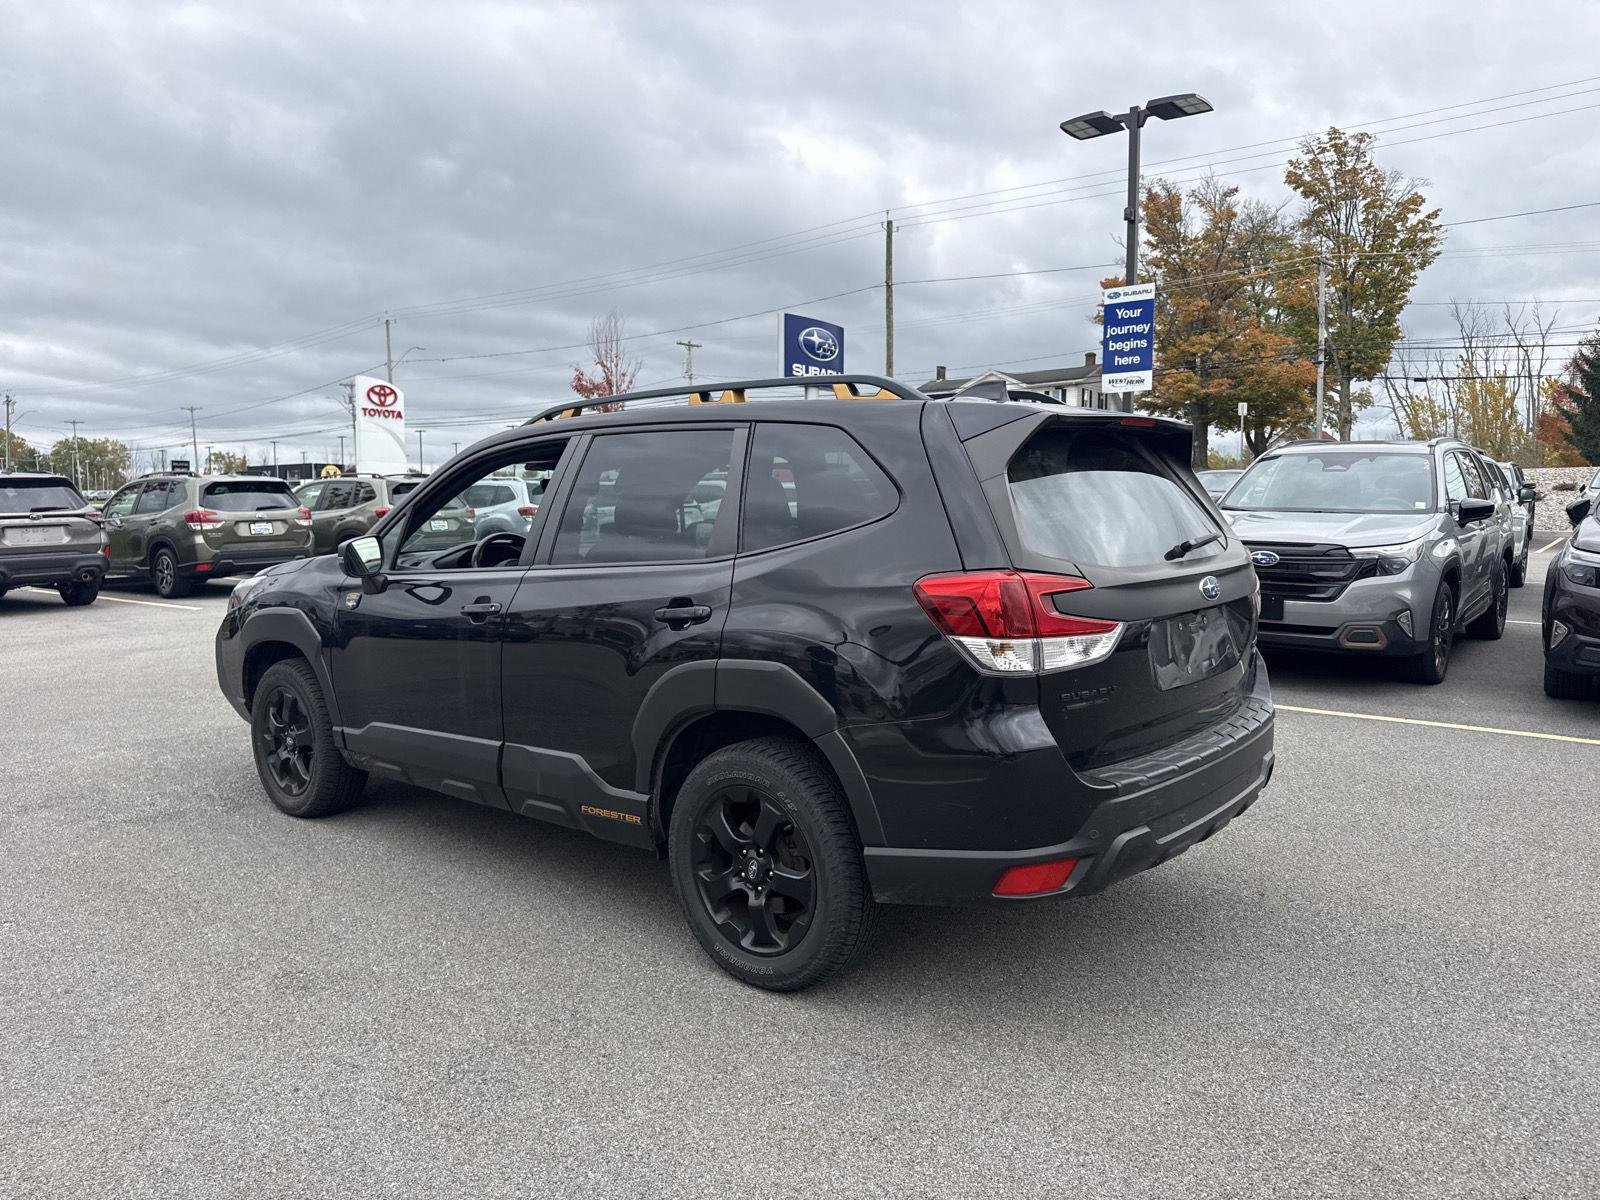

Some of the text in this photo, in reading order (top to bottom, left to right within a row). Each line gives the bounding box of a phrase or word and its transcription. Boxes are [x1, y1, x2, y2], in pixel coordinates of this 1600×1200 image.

[1122, 289, 1153, 297] SUBARU
[1116, 308, 1143, 319] Your
[1106, 323, 1151, 338] journey
[1108, 338, 1148, 352] begins
[1114, 355, 1141, 366] here
[361, 407, 403, 420] TOYOTA
[581, 805, 641, 823] FORESTER
